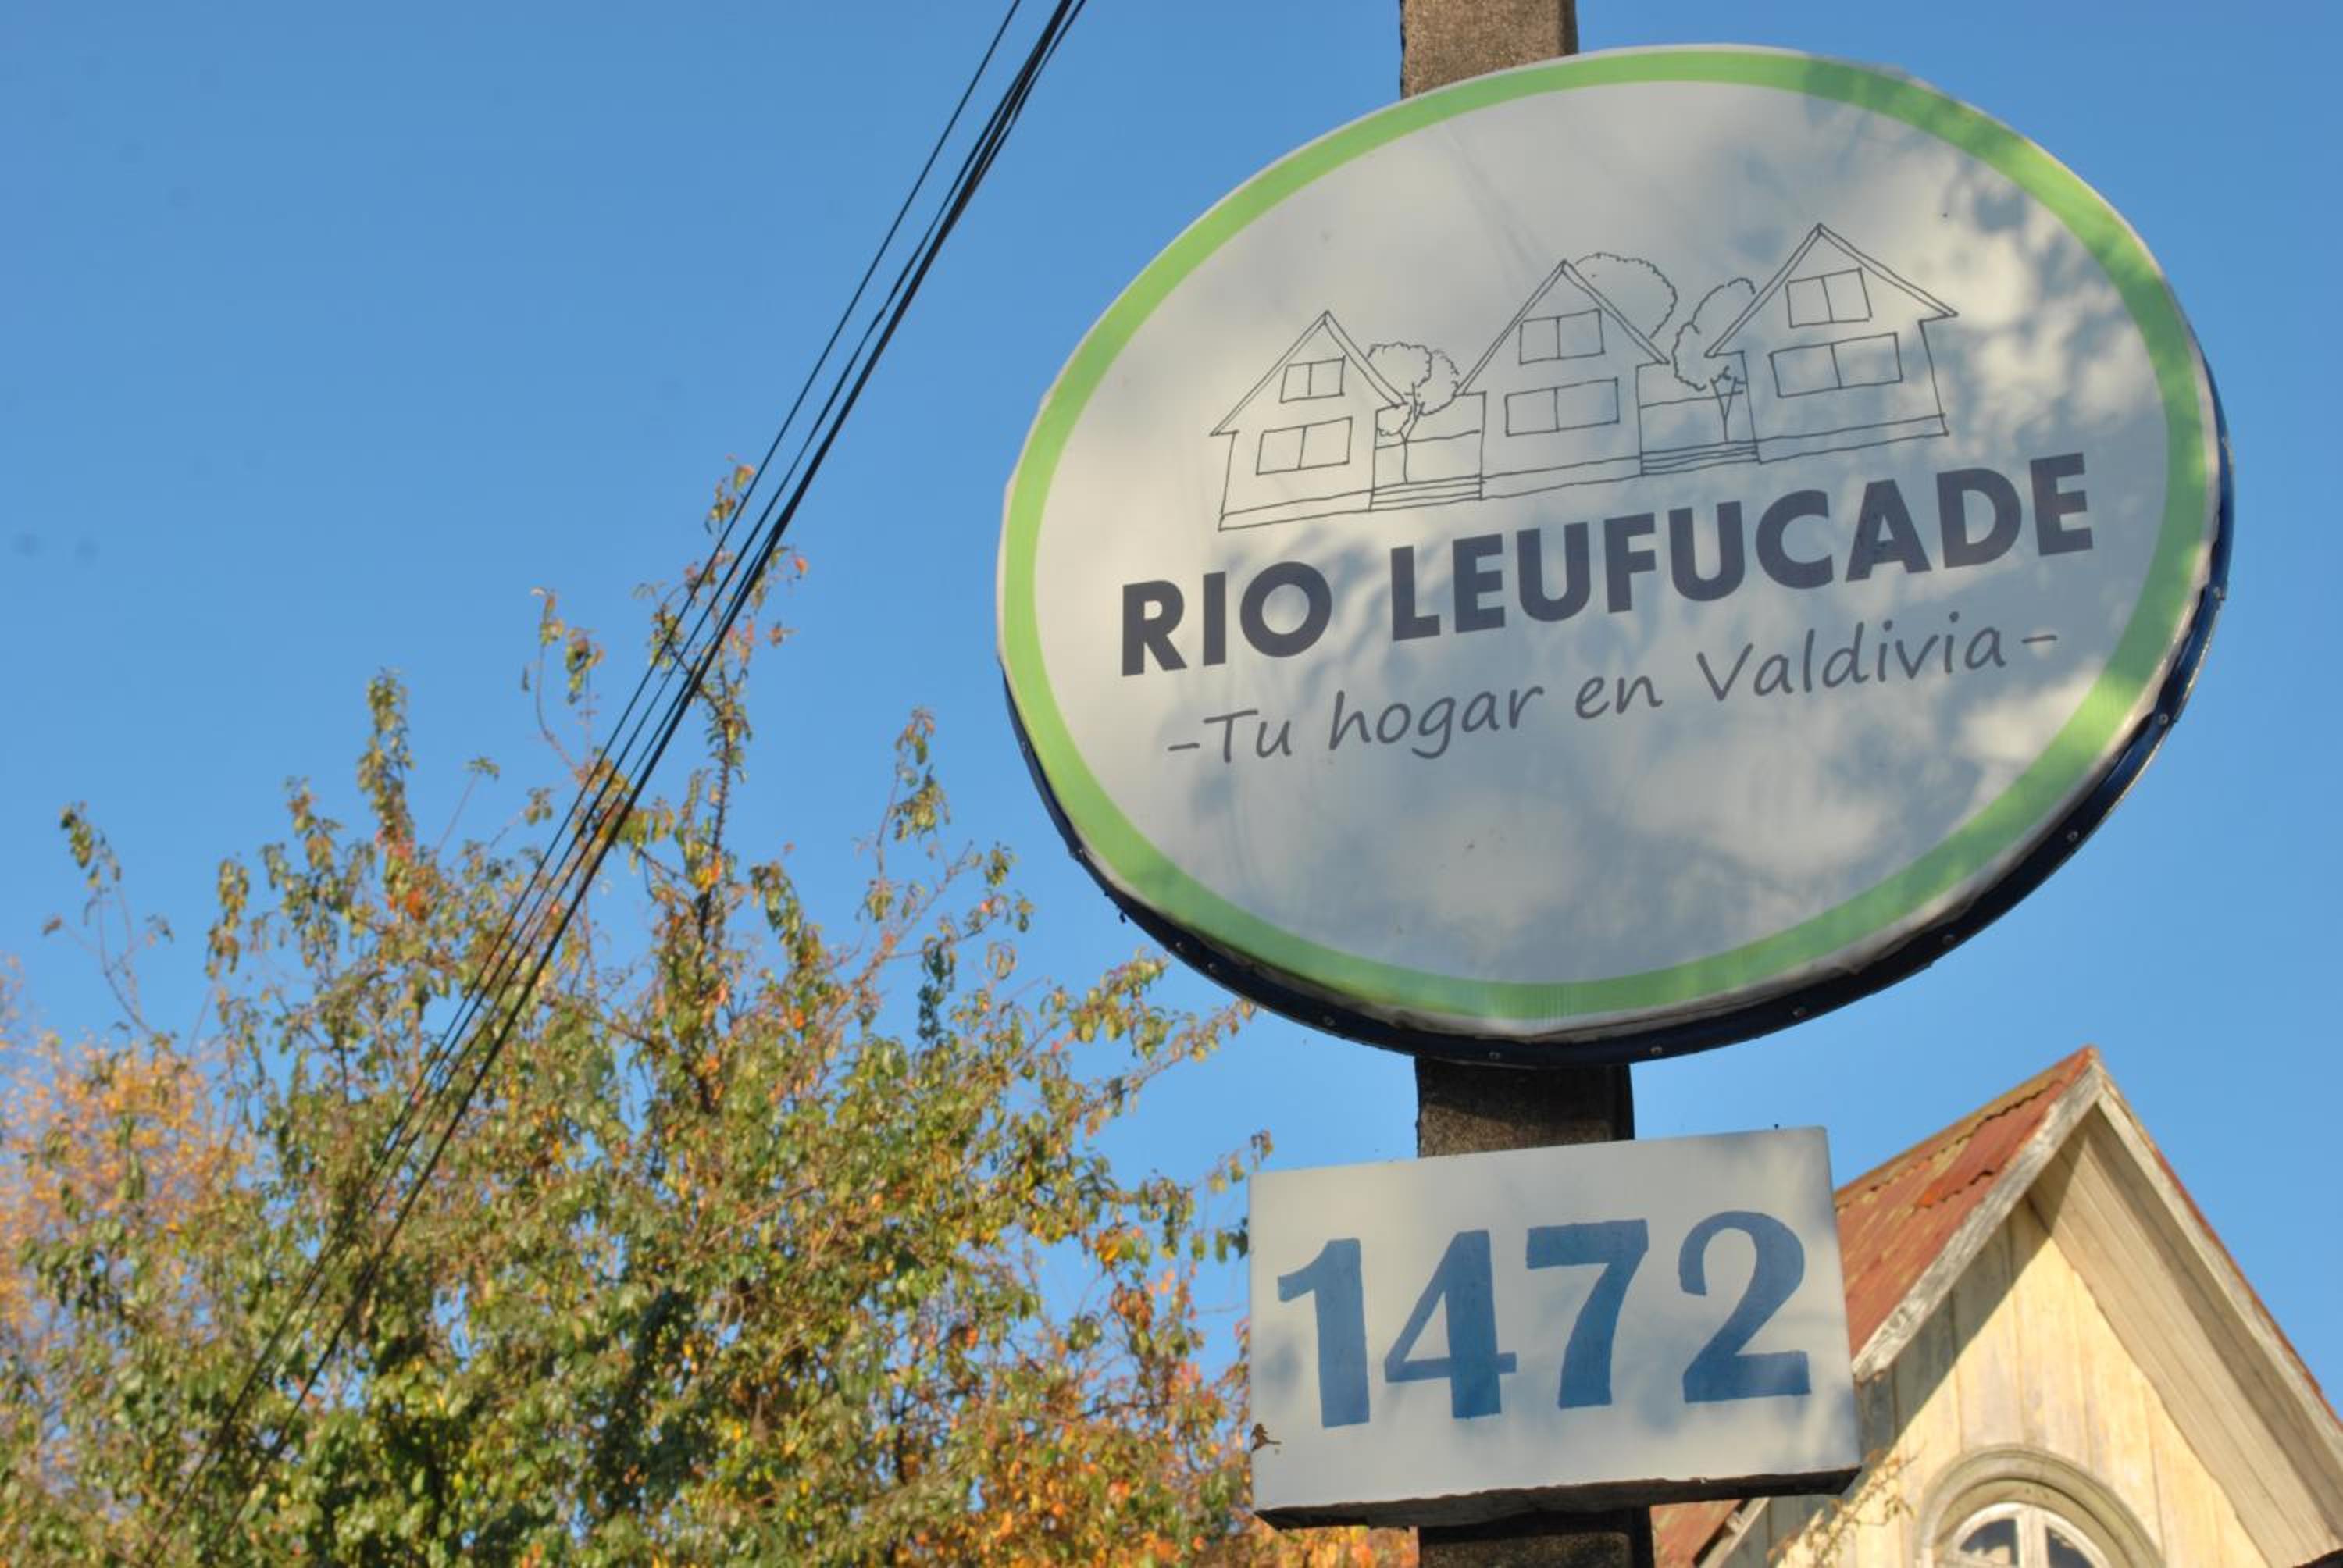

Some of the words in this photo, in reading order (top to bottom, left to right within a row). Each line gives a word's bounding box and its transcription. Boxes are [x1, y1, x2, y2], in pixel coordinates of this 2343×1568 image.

[1122, 561, 1332, 677] RIO
[1390, 451, 2094, 642] LEUFUCADE
[1329, 686, 1544, 759] hogar
[1574, 674, 1664, 719] en
[1277, 1210, 1812, 1427] 1472
